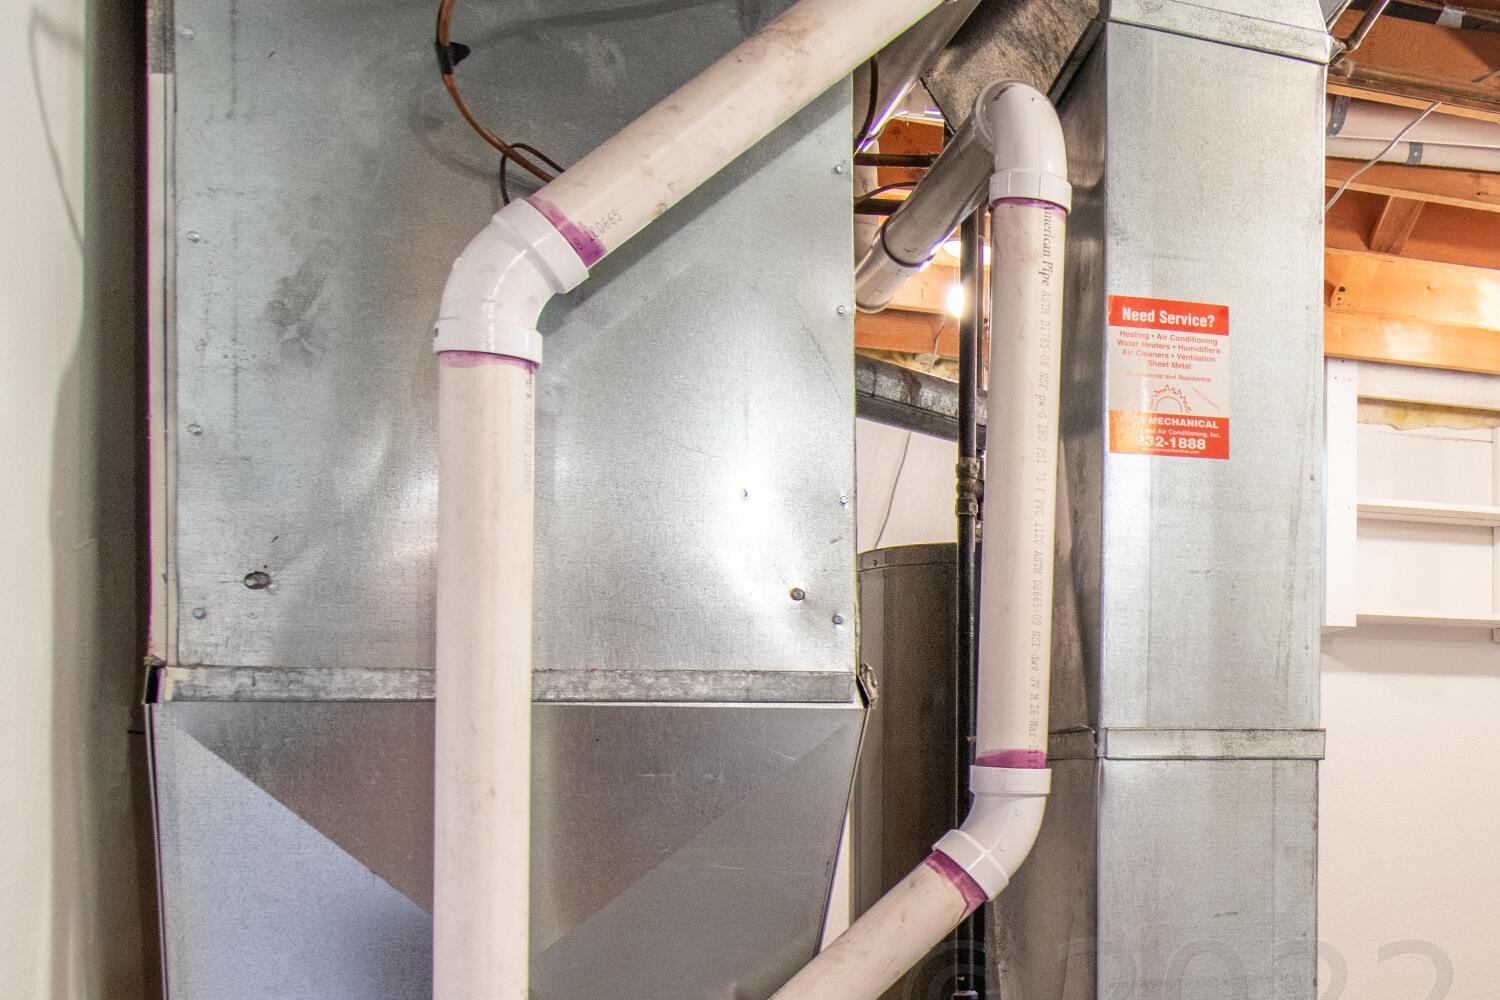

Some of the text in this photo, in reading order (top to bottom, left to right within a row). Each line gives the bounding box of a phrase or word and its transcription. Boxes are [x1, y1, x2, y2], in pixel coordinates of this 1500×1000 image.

[1038, 260, 1053, 287] Pipe
[1122, 307, 1215, 328] Need Service?
[1120, 330, 1218, 346] Heating Air Conditioning
[1117, 338, 1220, 354] Water Heaters Humidifiers
[1122, 349, 1216, 363] Air Cleaners Ventilation
[1147, 360, 1192, 370] Sheet Metal
[1165, 373, 1176, 381] and
[1178, 374, 1212, 383] Residential
[1149, 417, 1219, 429] MECHANICAL
[1168, 429, 1208, 438] Conditioning,
